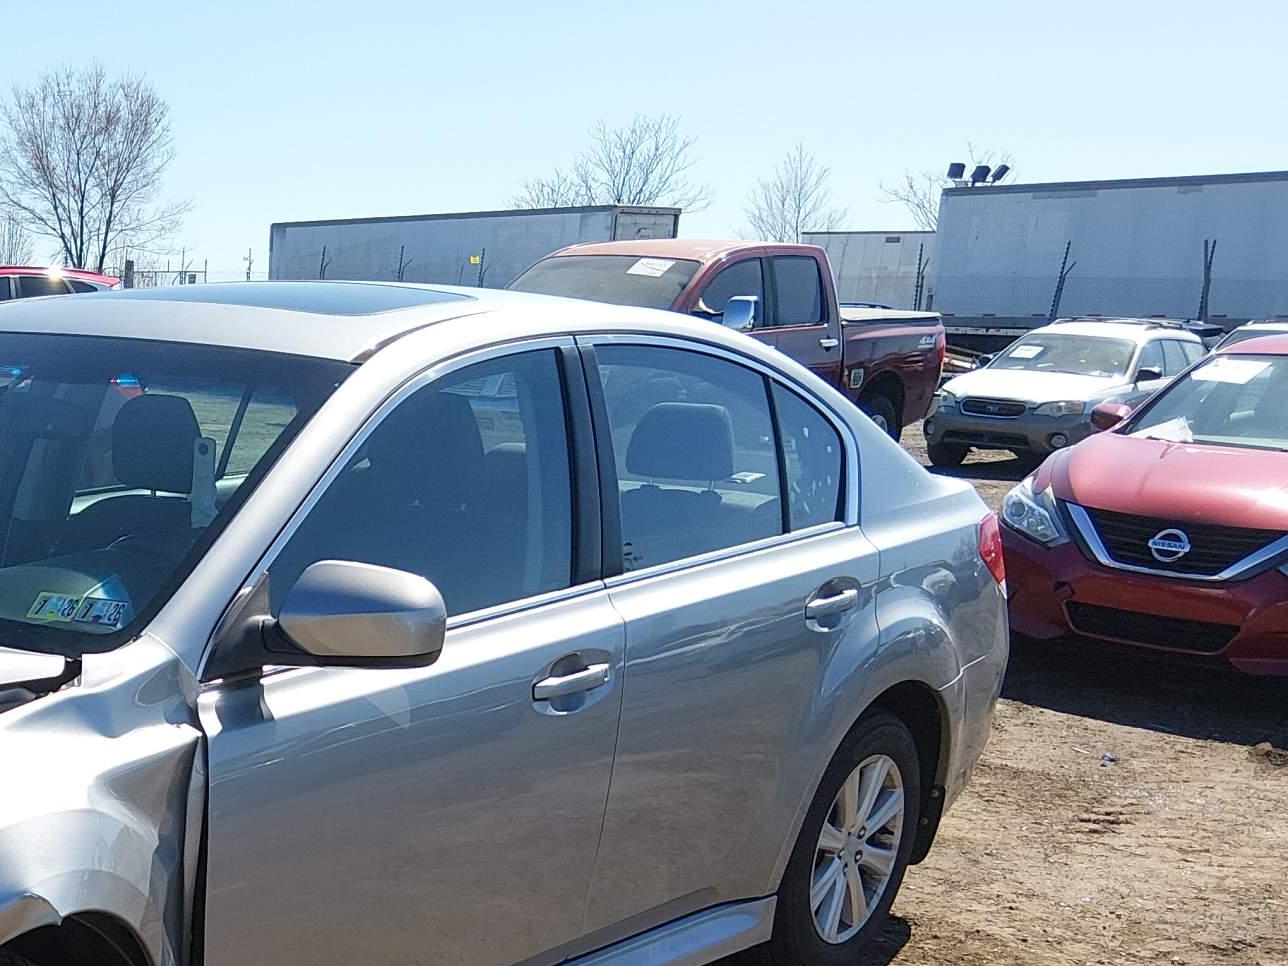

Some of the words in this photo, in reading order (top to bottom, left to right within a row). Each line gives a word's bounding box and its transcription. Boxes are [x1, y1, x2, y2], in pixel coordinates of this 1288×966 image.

[1151, 540, 1186, 550] NISSAN
[34, 599, 47, 612] 7
[61, 598, 79, 617] 26
[80, 602, 93, 620] 7
[106, 603, 125, 623] 26
